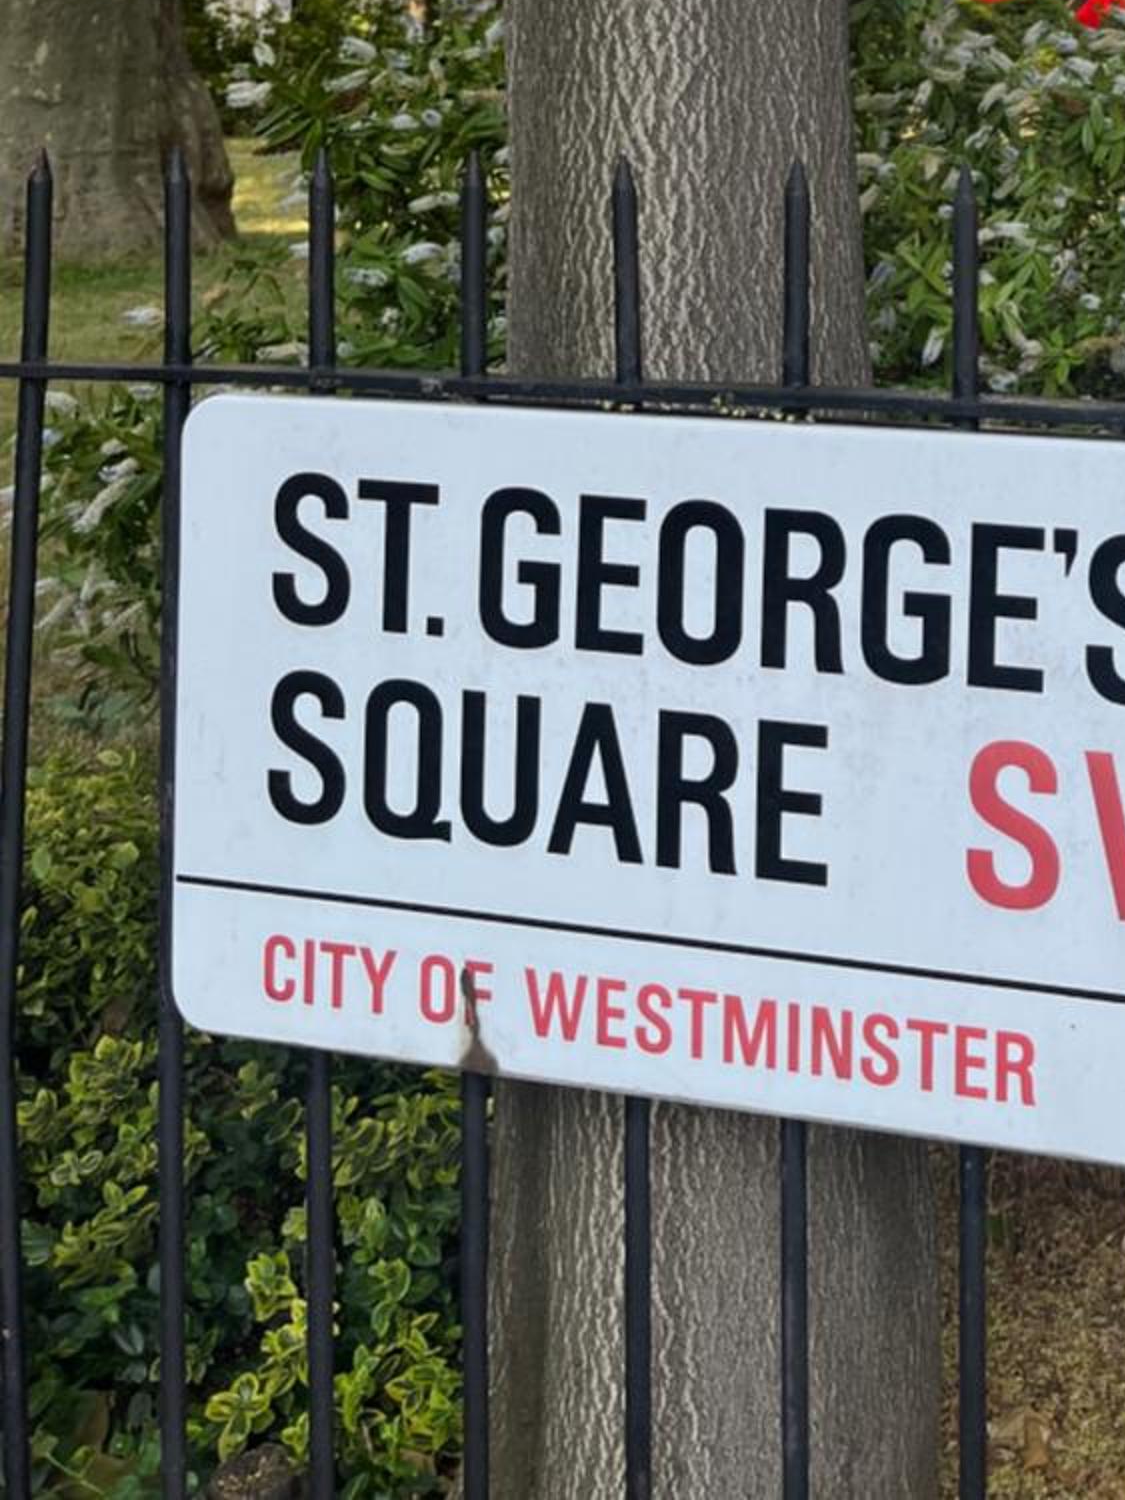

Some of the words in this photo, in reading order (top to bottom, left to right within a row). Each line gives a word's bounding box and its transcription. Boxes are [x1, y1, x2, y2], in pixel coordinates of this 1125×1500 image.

[272, 472, 444, 637] ST.
[268, 670, 828, 887] SQUARE
[262, 935, 395, 1013] CITY
[419, 954, 494, 1027] OF
[525, 967, 1035, 1106] WESTMINSTER
